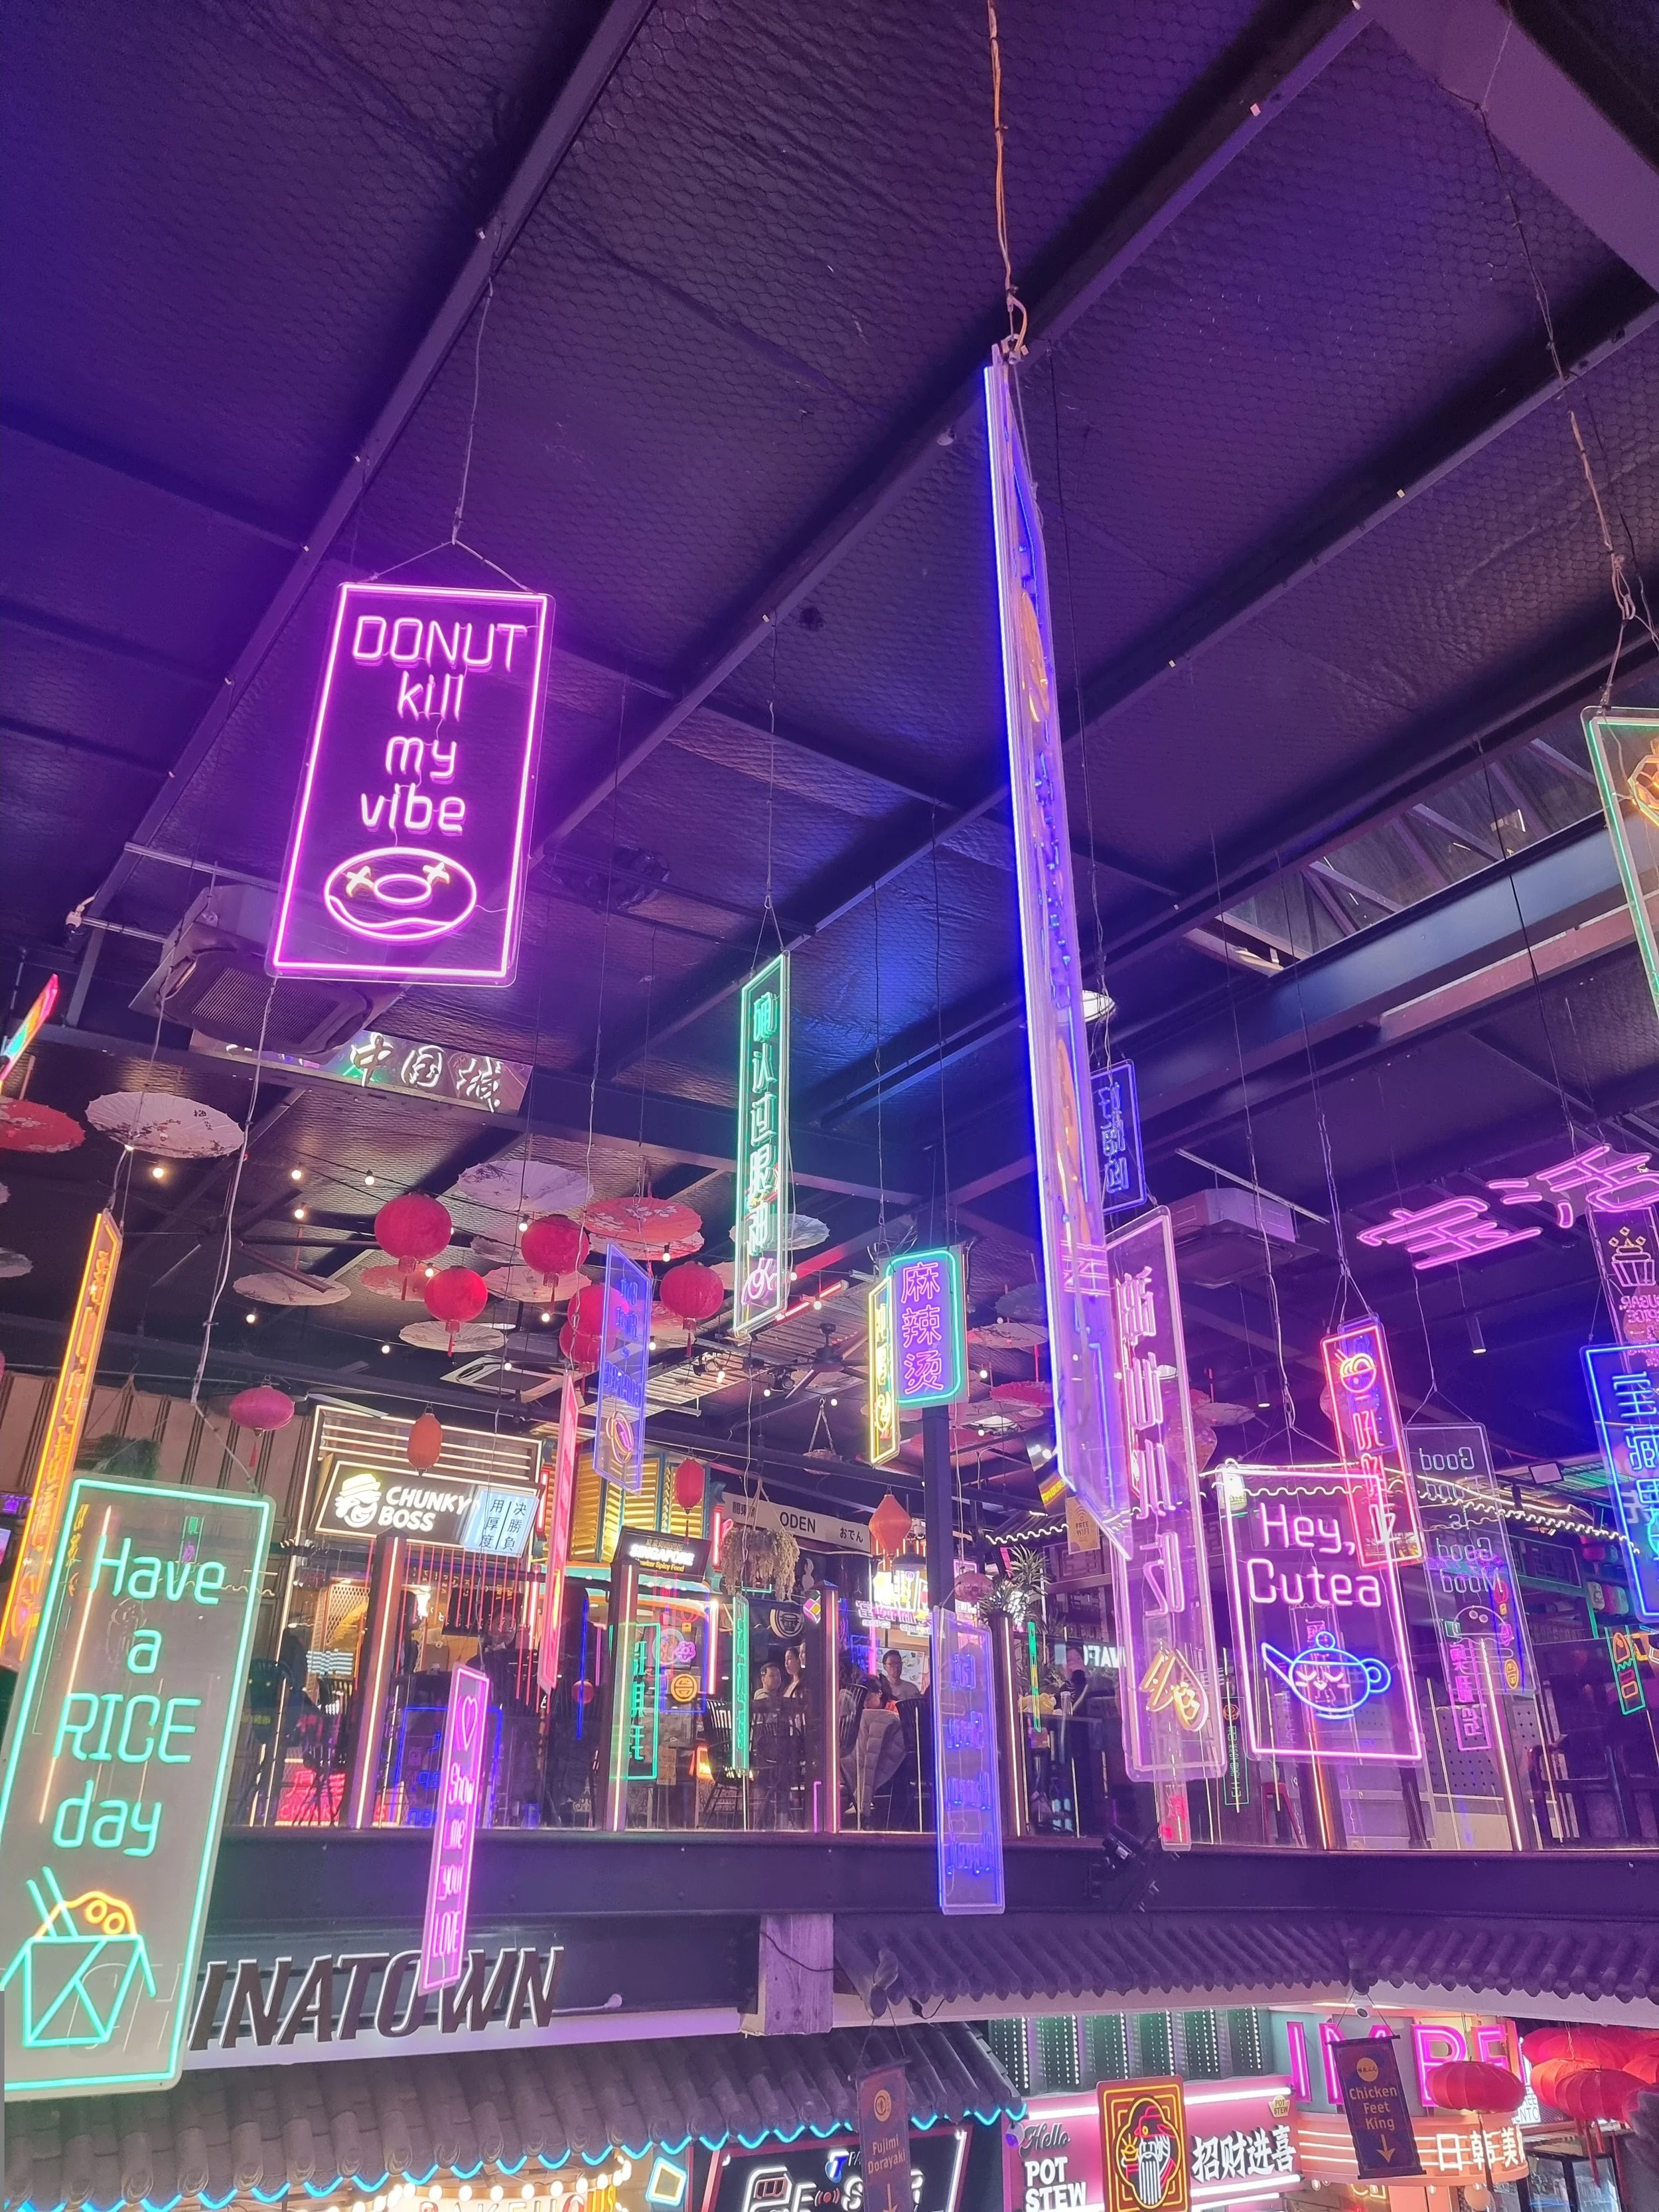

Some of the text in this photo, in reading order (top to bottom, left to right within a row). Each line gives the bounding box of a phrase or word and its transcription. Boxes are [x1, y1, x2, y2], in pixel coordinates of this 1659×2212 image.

[352, 615, 528, 672] DONUT
[397, 670, 465, 722] kill
[385, 735, 458, 784] my
[360, 782, 467, 837] vibe
[900, 1260, 945, 1395] 麻辣烫
[378, 1506, 437, 1532] BOSS
[386, 1486, 472, 1516] CHUNKY
[478, 1499, 504, 1549] 用厚度
[779, 1511, 817, 1534] ODEN
[839, 1526, 864, 1544] おでん
[1076, 1528, 1090, 1536] WIFI
[1260, 1502, 1356, 1556] Hey,
[89, 1534, 226, 1605] Have
[654, 1560, 671, 1572] Spicy
[670, 1563, 685, 1572] Food
[1247, 1558, 1382, 1607] Cutea
[126, 1625, 164, 1676] a
[52, 1692, 203, 1765] RICE
[448, 1761, 476, 1806] Show
[52, 1779, 164, 1857] day
[449, 1819, 466, 1852] me
[441, 1863, 463, 1901] your
[433, 1909, 461, 1957] LOVE
[1273, 2098, 1286, 2107] POT
[1273, 2106, 1289, 2116] STEW
[1348, 2086, 1398, 2101] Chicken
[1362, 2101, 1390, 2114] Feet
[1019, 2121, 1071, 2157] Hello
[1365, 2116, 1396, 2131] King
[867, 2148, 906, 2175] Dorayaki
[871, 2134, 901, 2156] Fujimi
[1191, 2124, 1297, 2183] 招财进喜
[1024, 2156, 1068, 2187] POT
[1025, 2181, 1088, 2212] STEW
